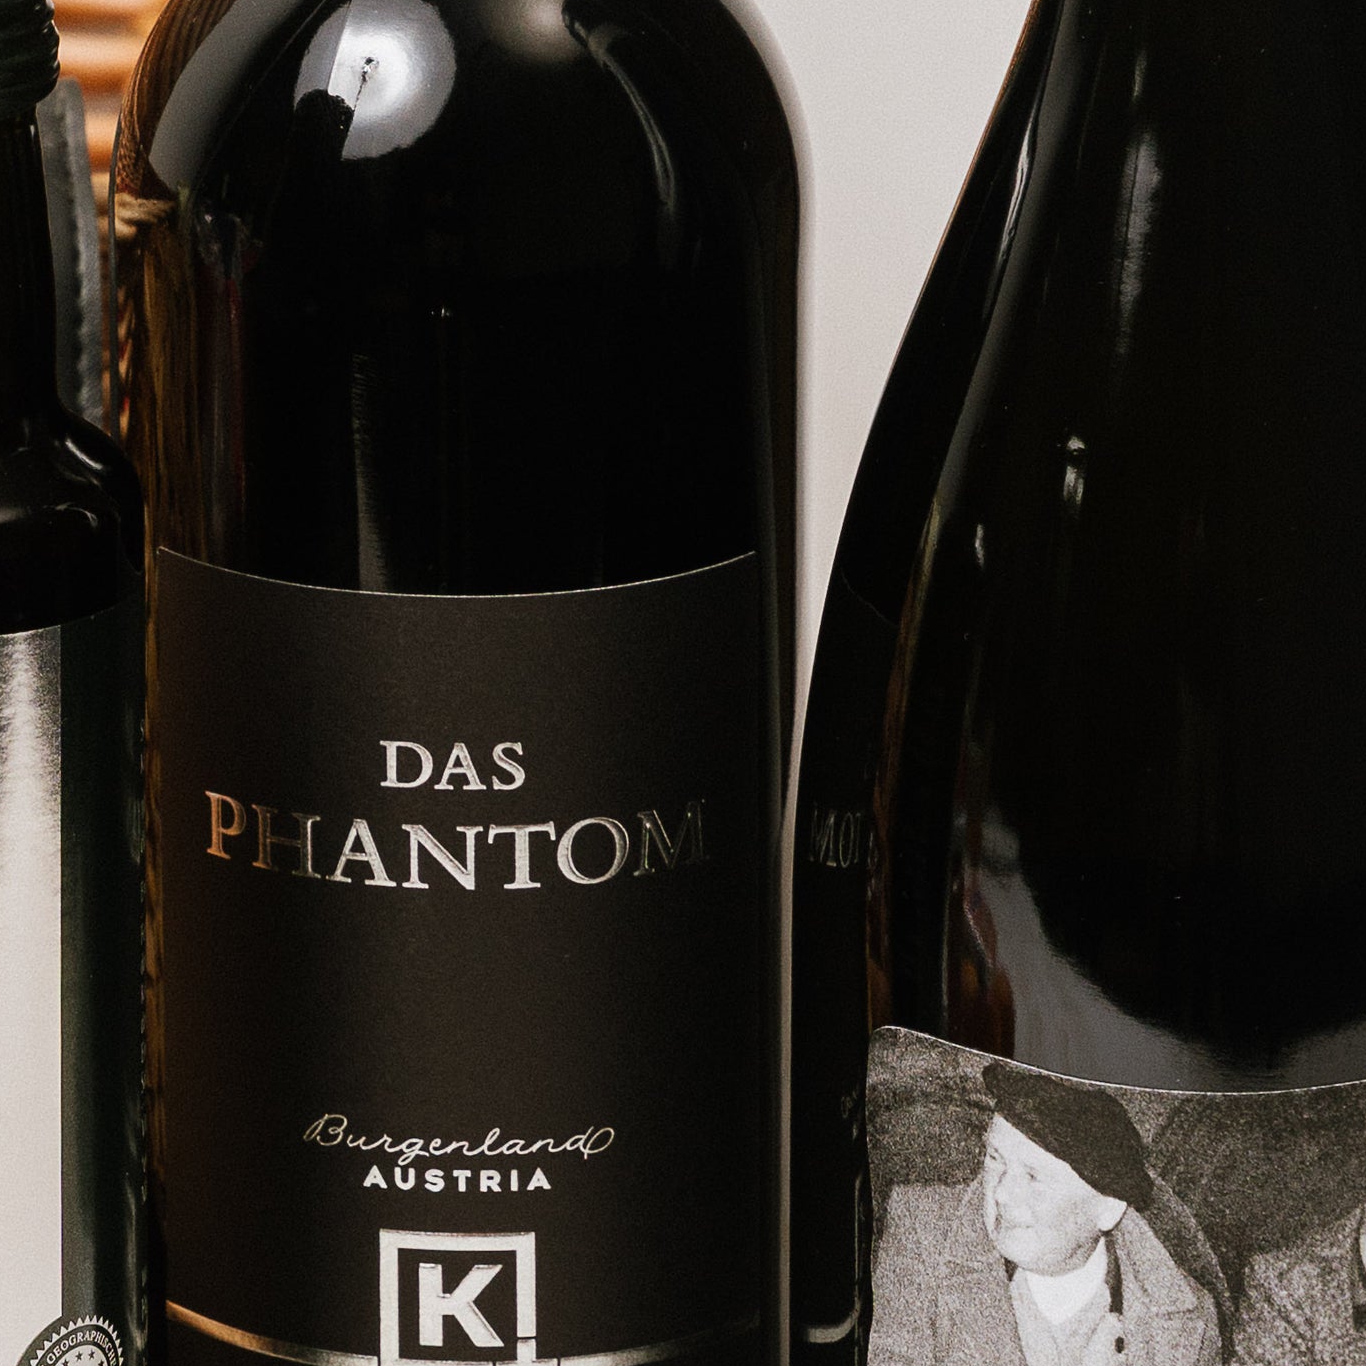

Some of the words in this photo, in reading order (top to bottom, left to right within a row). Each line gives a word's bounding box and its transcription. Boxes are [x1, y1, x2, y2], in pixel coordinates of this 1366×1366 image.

[379, 739, 526, 791] DAS
[204, 790, 710, 890] PHANTOM
[303, 1113, 616, 1165] Burgenland
[363, 1165, 552, 1193] AUSTRIA
[418, 1262, 505, 1348] K
